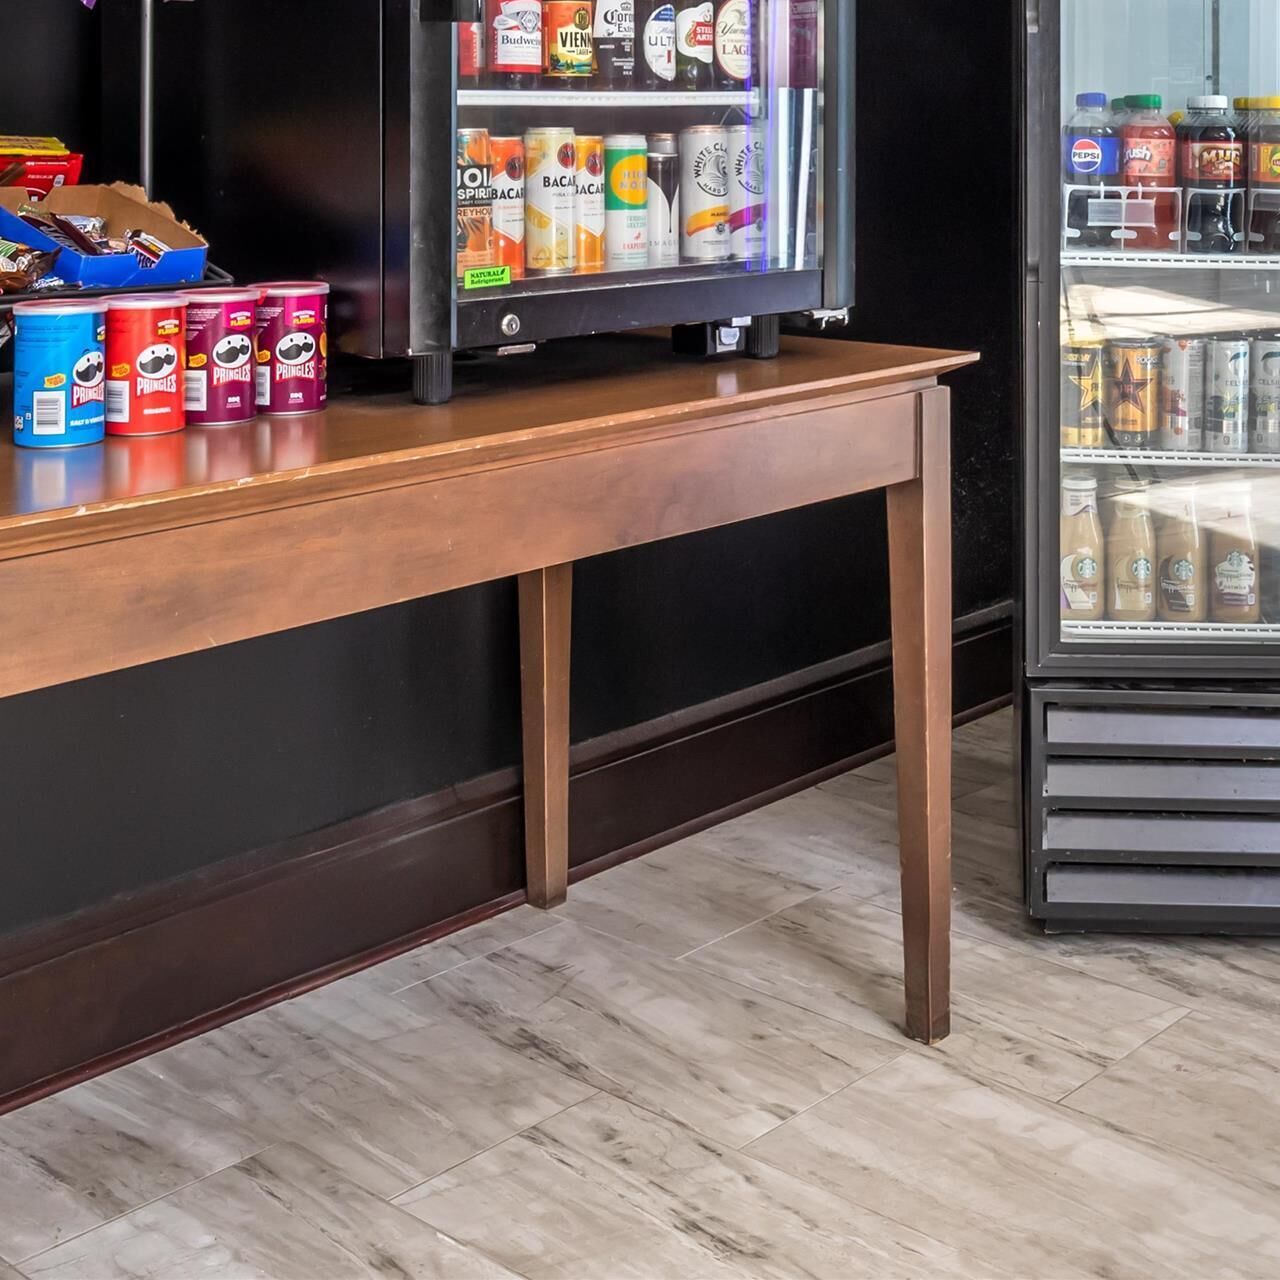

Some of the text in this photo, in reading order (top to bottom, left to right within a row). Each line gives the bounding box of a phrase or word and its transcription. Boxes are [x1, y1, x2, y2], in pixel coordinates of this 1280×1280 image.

[694, 147, 712, 178] WHITE
[735, 144, 752, 177] WHITE
[1072, 152, 1100, 160] PEPSI
[1124, 145, 1152, 161] rush
[1202, 150, 1240, 165] MUG
[470, 270, 500, 279] NATURAL
[213, 364, 250, 385] PRINGLES
[276, 361, 314, 380] PRINGLES
[72, 382, 104, 406] PRINGLE
[137, 374, 176, 395] PRINGLES
